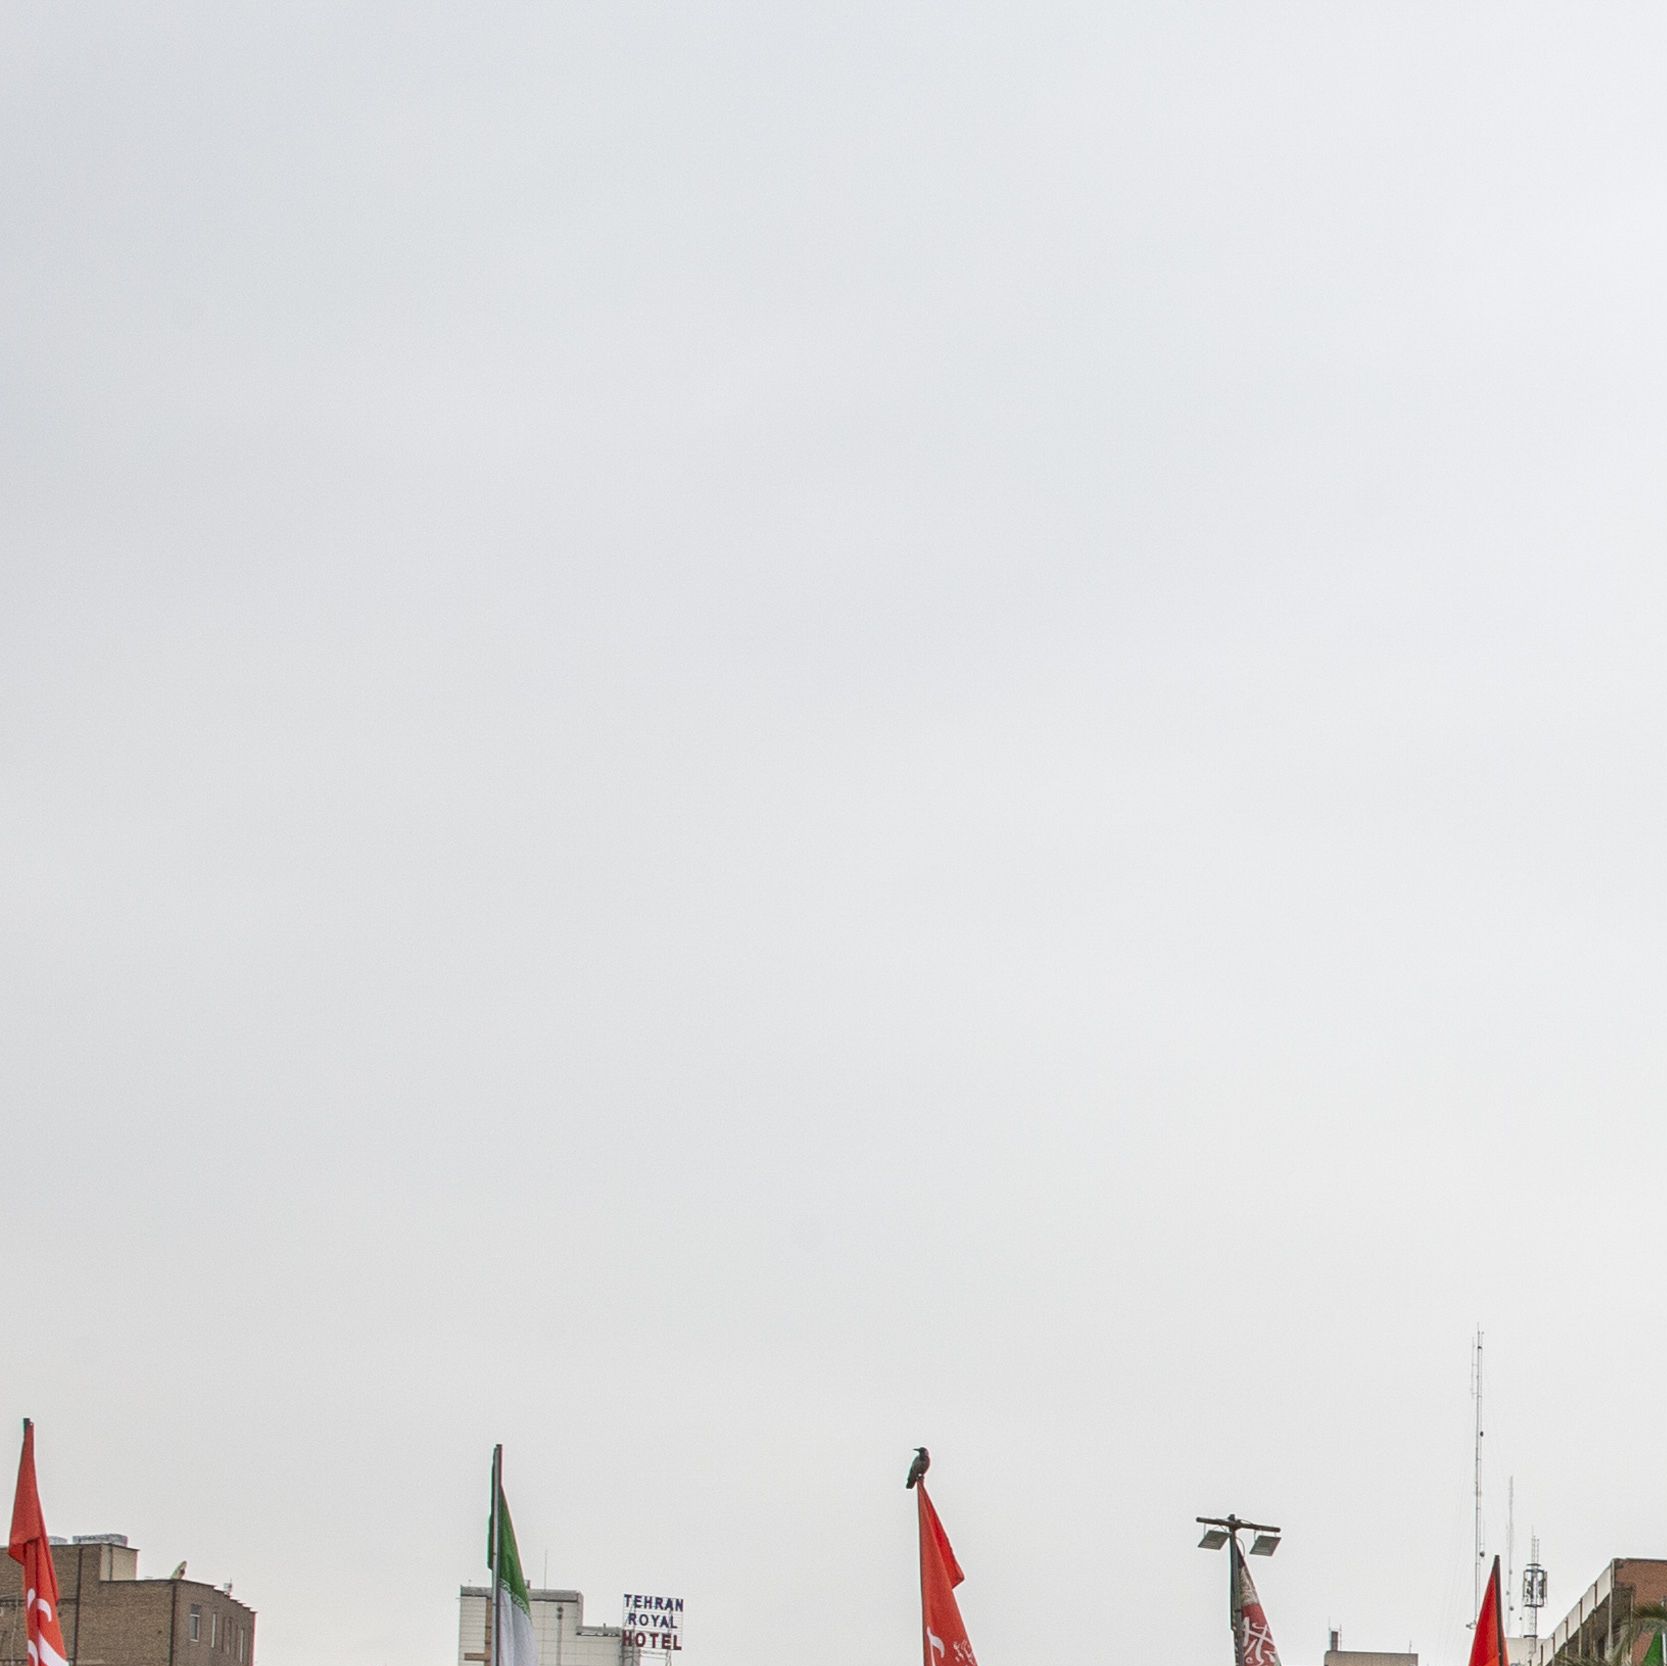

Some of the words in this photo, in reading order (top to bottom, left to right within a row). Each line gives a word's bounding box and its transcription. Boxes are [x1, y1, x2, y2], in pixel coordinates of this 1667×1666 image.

[624, 1593, 684, 1612] TEHRAN
[628, 1613, 678, 1629] ROYAL
[622, 1629, 682, 1651] HOTEL
